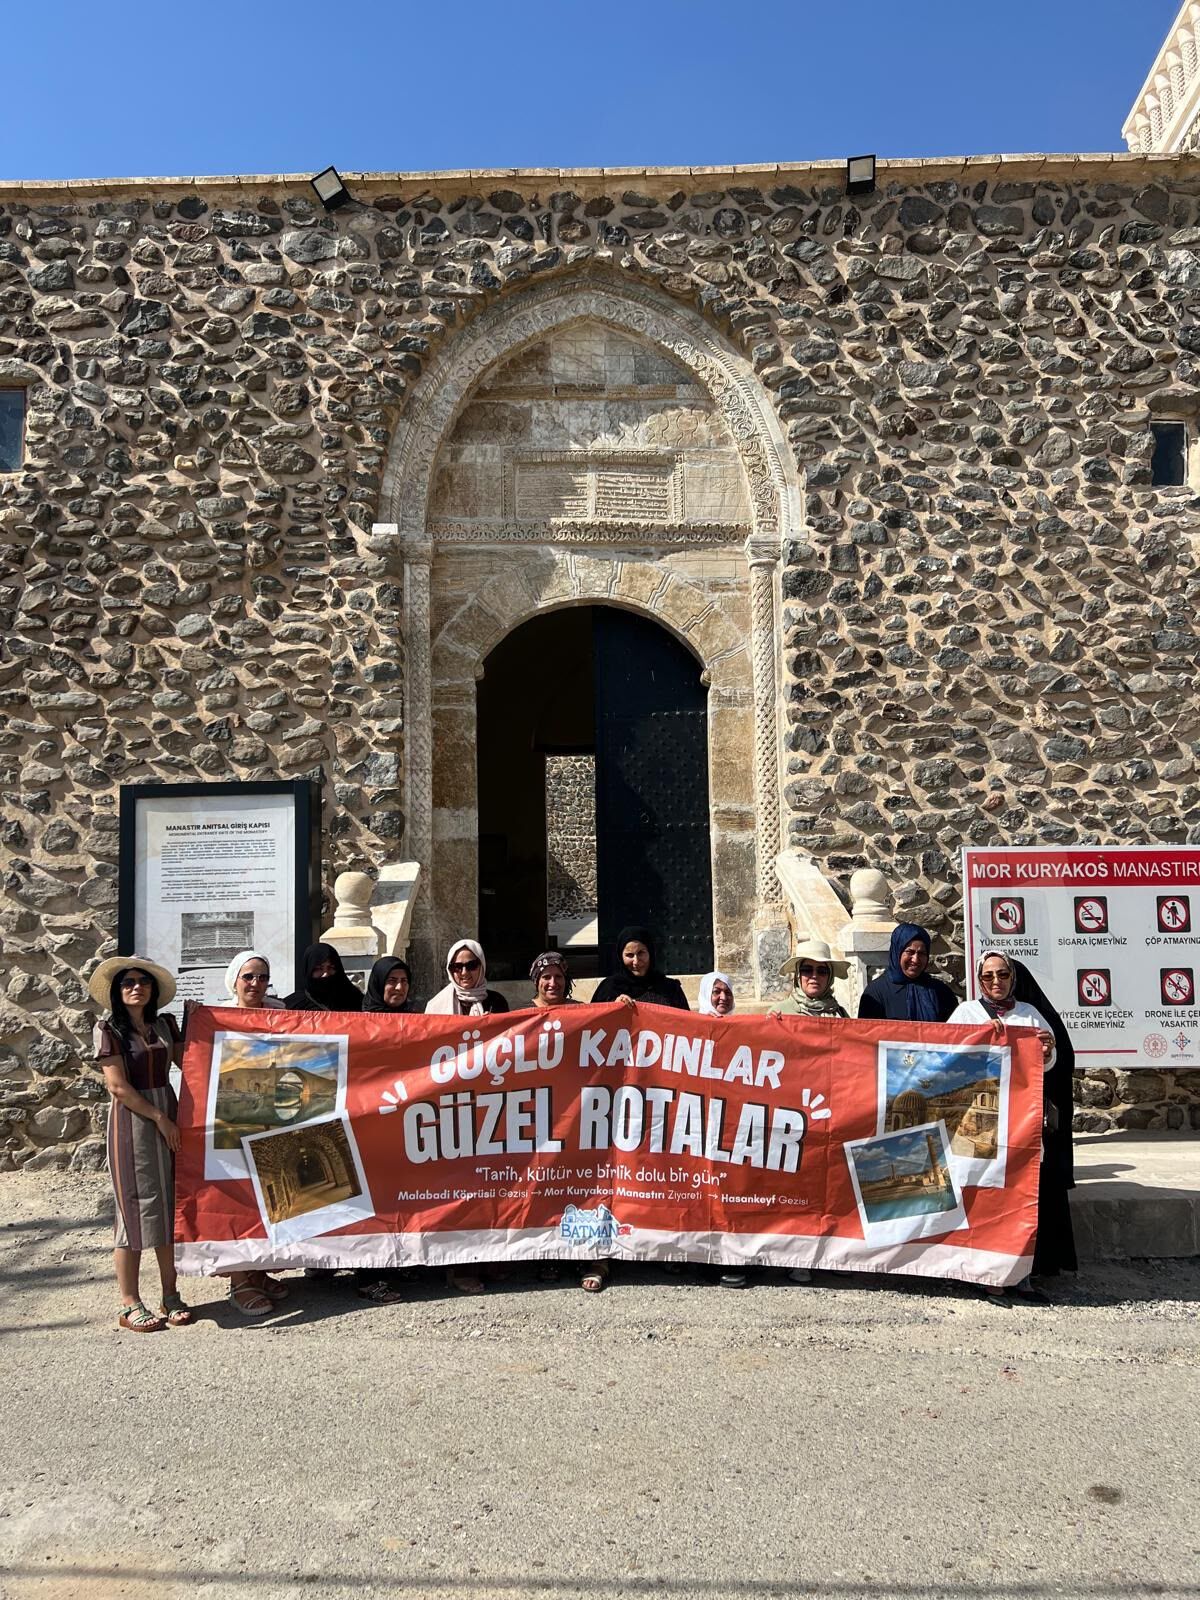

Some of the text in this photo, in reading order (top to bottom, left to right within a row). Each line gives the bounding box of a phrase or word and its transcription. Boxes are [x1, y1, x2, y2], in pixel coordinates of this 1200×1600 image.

[230, 822, 247, 830] GİRİŞ
[972, 863, 1011, 878] MOR
[1016, 862, 1108, 878] KURYAKOS
[980, 938, 1012, 946] YÜKSEK
[1058, 937, 1127, 947] SİGARA İÇMEYİNİZ
[1145, 936, 1161, 946] ÇÖP
[1104, 1009, 1134, 1019] İÇECEK
[1174, 1009, 1186, 1017] İLE
[1188, 1010, 1200, 1018] ÇE
[1067, 1020, 1125, 1029] İLE GİRMEYİNİZ
[430, 1021, 786, 1090] GÜÇLÜ KADINLAR
[403, 1086, 806, 1174] GÜZEL ROTALAR
[527, 1167, 572, 1182] kültür
[576, 1169, 593, 1179] ve
[597, 1164, 632, 1181] birlik
[636, 1166, 666, 1182] dolu
[669, 1167, 689, 1182] bir
[398, 1185, 808, 1205] Malabadi Köprüsü Gezisi Mor Kuryakos Manastırı Ziyareti Hasankeyf Gezisi
[561, 1224, 618, 1238] BATMAN
